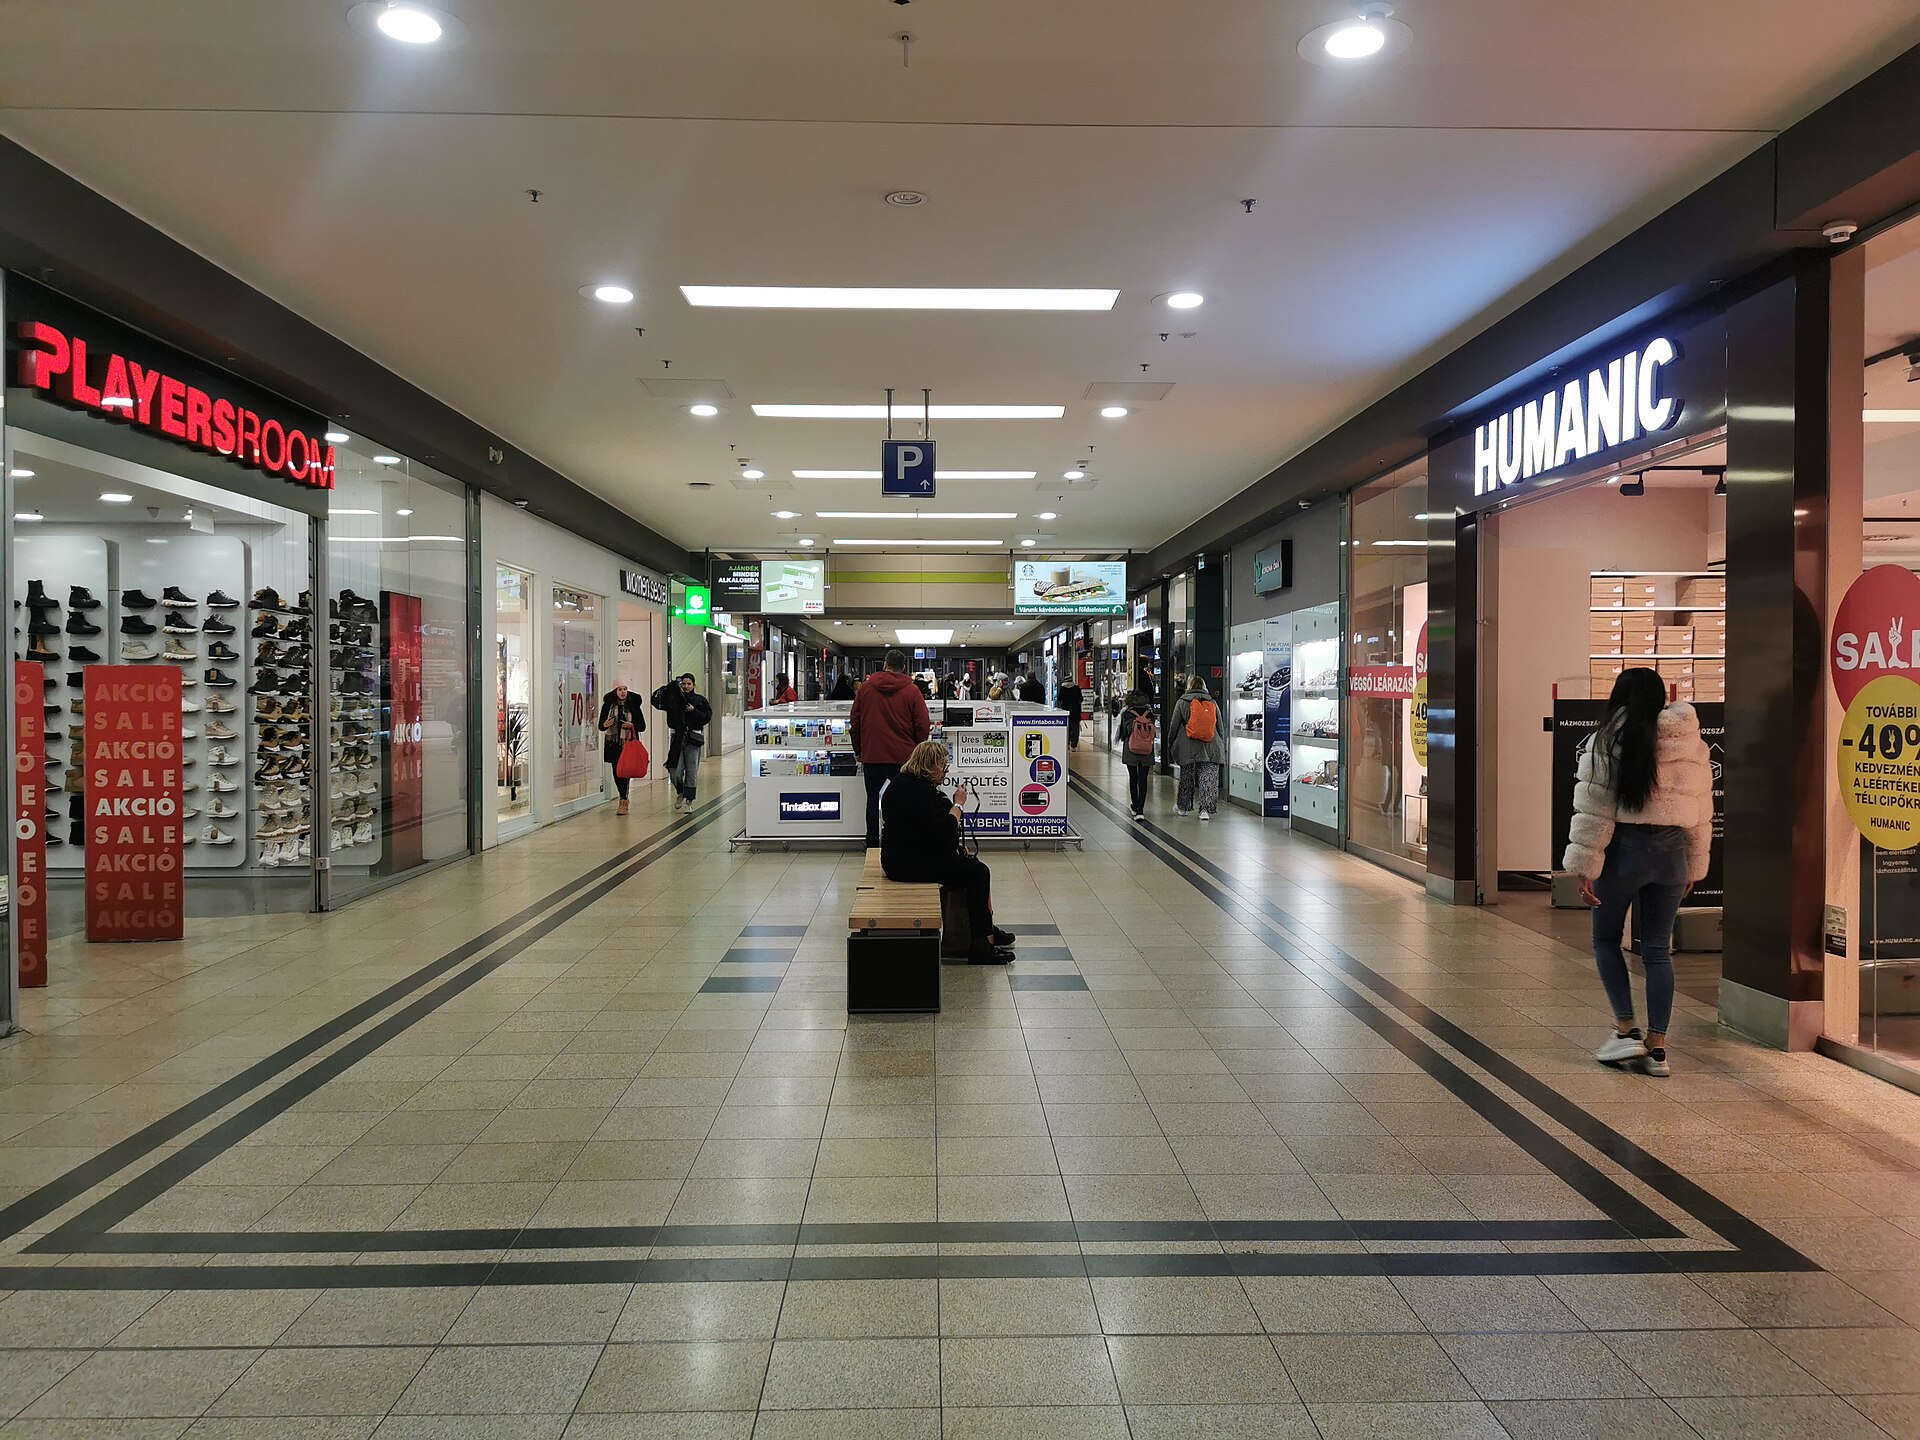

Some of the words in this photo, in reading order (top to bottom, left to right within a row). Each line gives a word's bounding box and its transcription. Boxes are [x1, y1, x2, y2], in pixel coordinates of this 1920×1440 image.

[19, 321, 335, 490] PLAYERSROOM
[1474, 337, 1678, 497] HUMANIC
[897, 445, 923, 479] P
[95, 678, 174, 702] AKCIÓ
[1349, 673, 1373, 692] VÉGSŐ
[1373, 672, 1413, 693] LEÁRAZÁS
[1866, 703, 1917, 718] TOVÁBBI
[94, 711, 175, 730] SALE
[1016, 718, 1064, 726] www.tintabox.hu
[94, 735, 175, 760] AKCIÓ
[961, 735, 980, 744] Üres
[961, 746, 1004, 756] tintapatron
[961, 756, 1006, 764] felvásárlás!
[94, 769, 175, 788] SALE
[962, 775, 1008, 787] TÖLTÉS
[1853, 778, 1861, 788] A
[95, 791, 176, 816] AKCIÓ
[1855, 791, 1877, 805] TÉLI
[1013, 825, 1065, 835] TONEREK
[1870, 816, 1911, 832] HUMANIC
[95, 826, 176, 844] SALE
[95, 848, 176, 872] AKCIÓ
[95, 882, 176, 900] SALE
